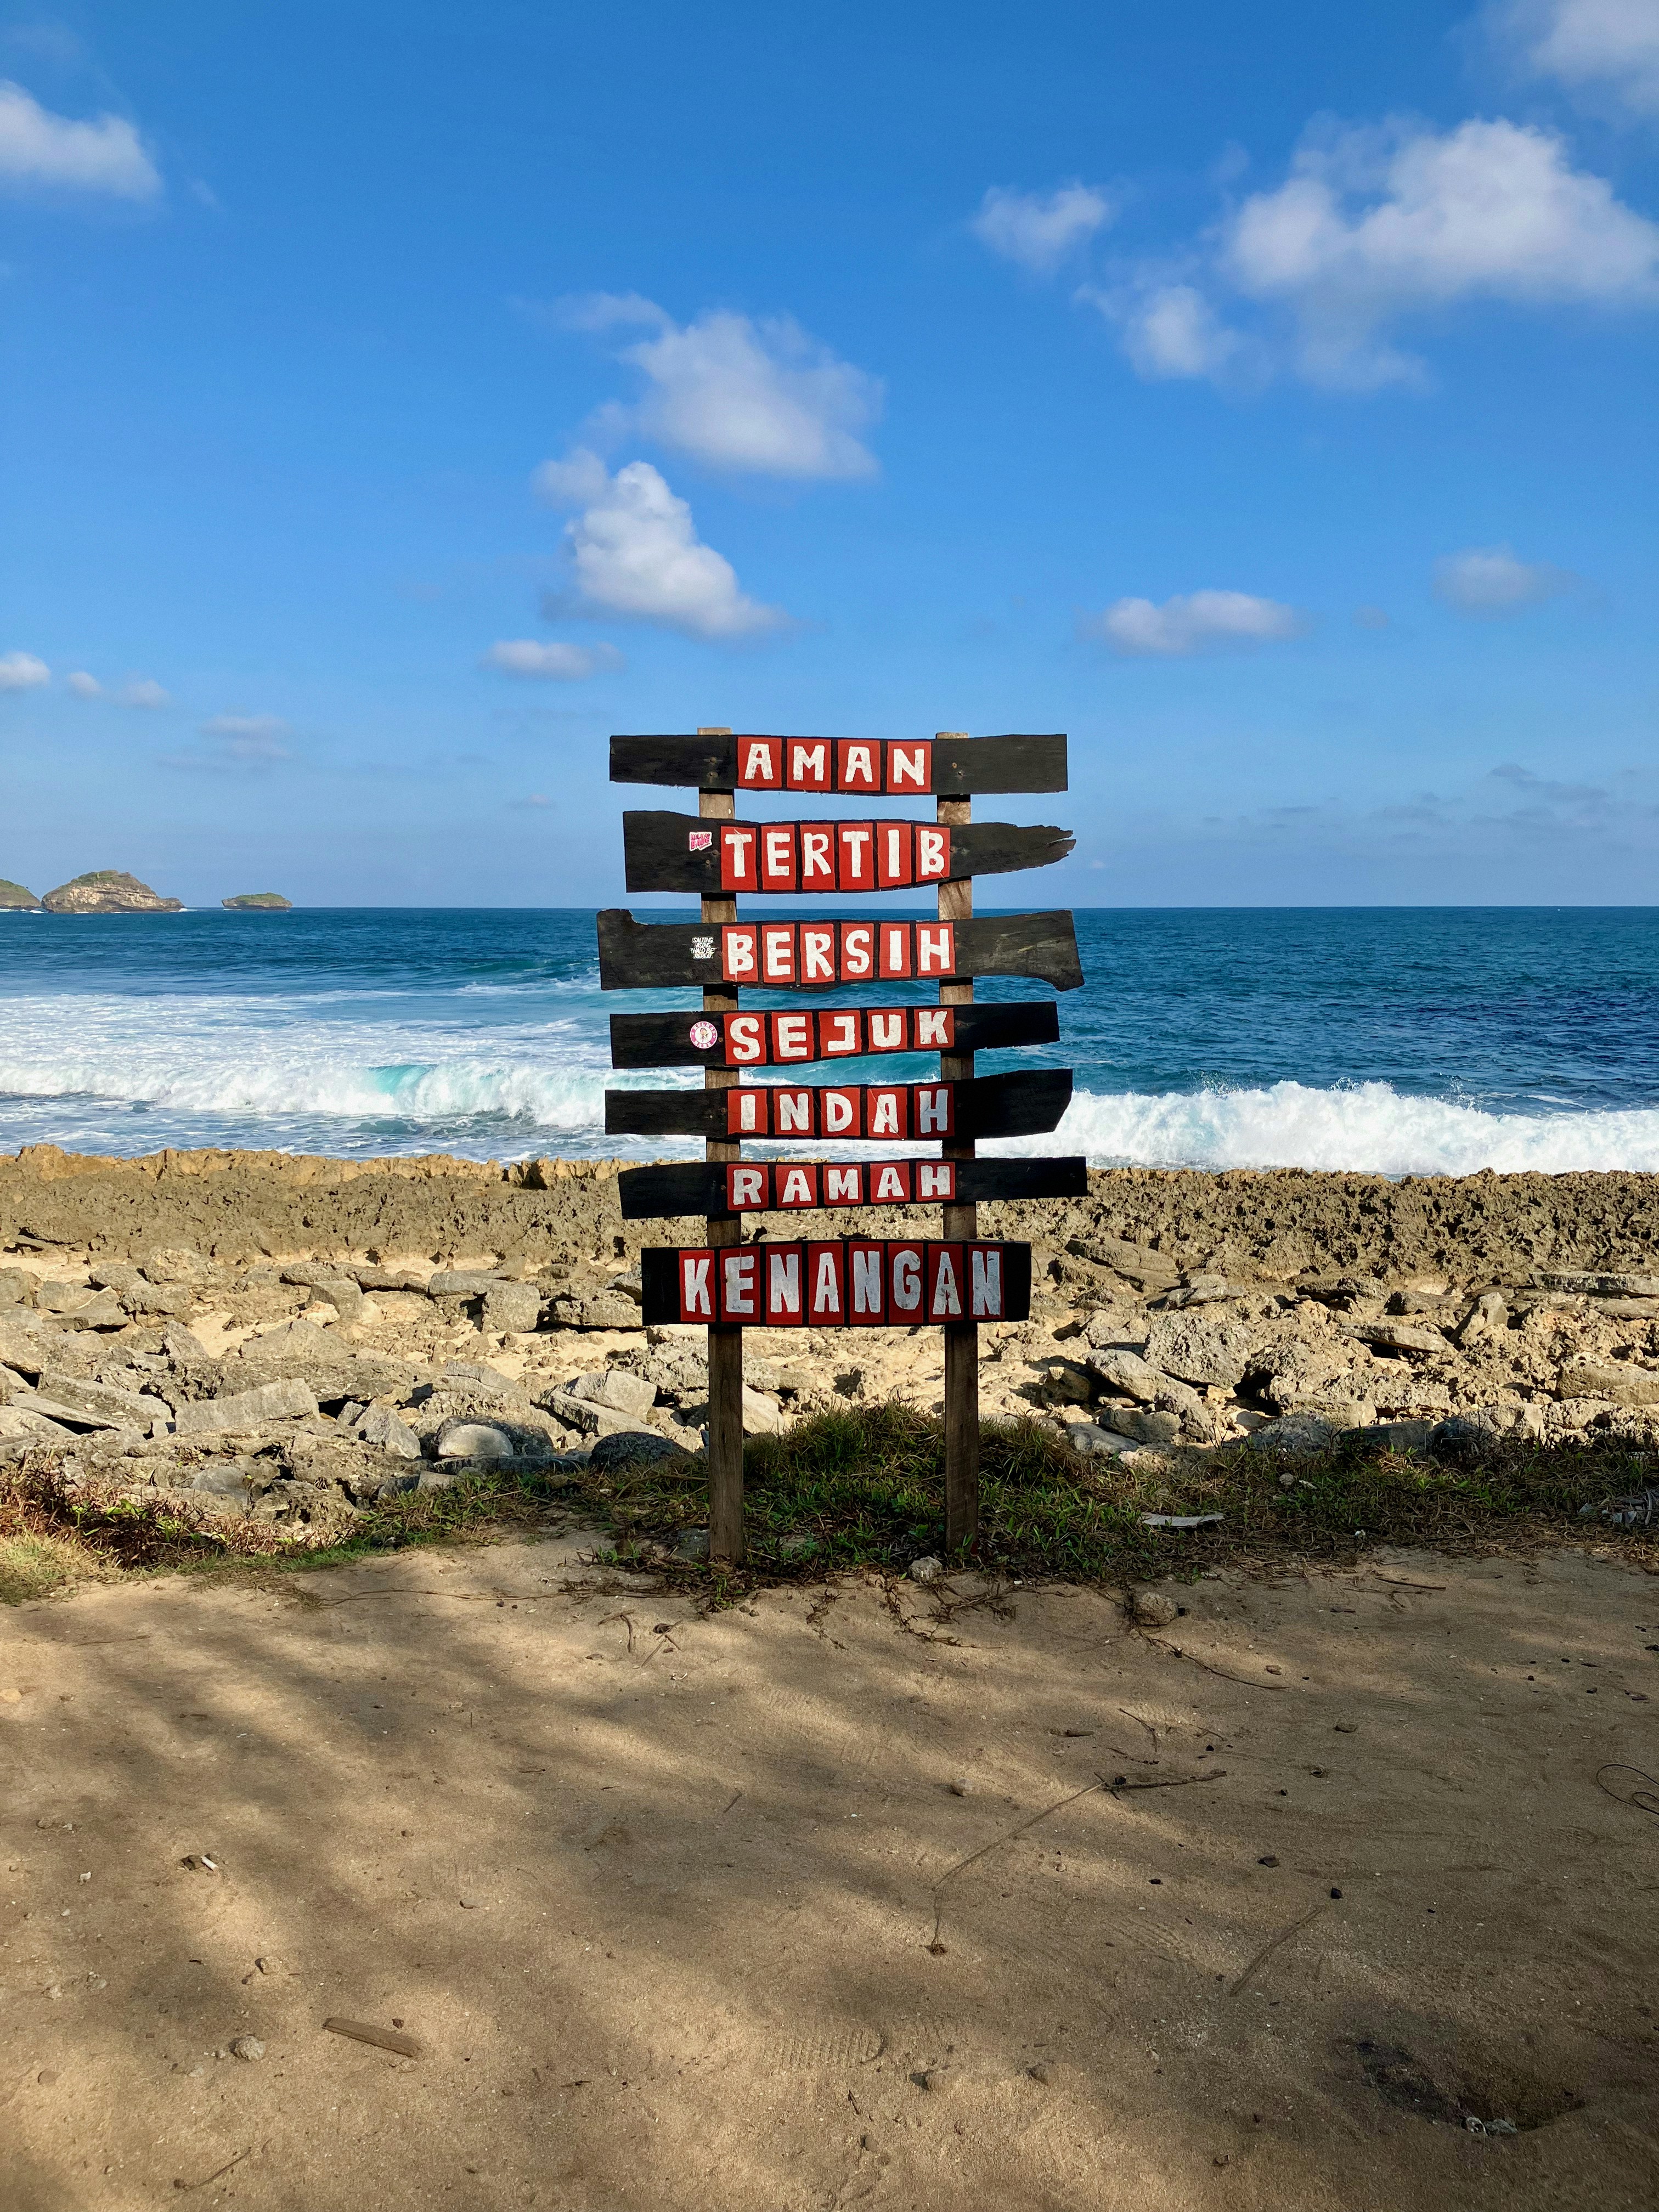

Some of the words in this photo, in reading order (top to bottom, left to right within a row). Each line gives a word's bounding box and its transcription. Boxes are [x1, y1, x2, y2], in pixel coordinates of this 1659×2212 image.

[744, 743, 925, 786] AMAN
[725, 828, 945, 878] TERTIB
[727, 928, 950, 980] BERSIH
[730, 1011, 949, 1060] SEJUK
[741, 1089, 949, 1134] INDAH
[733, 1164, 951, 1205] RAMAH
[684, 1250, 1001, 1316] KENANGAN
